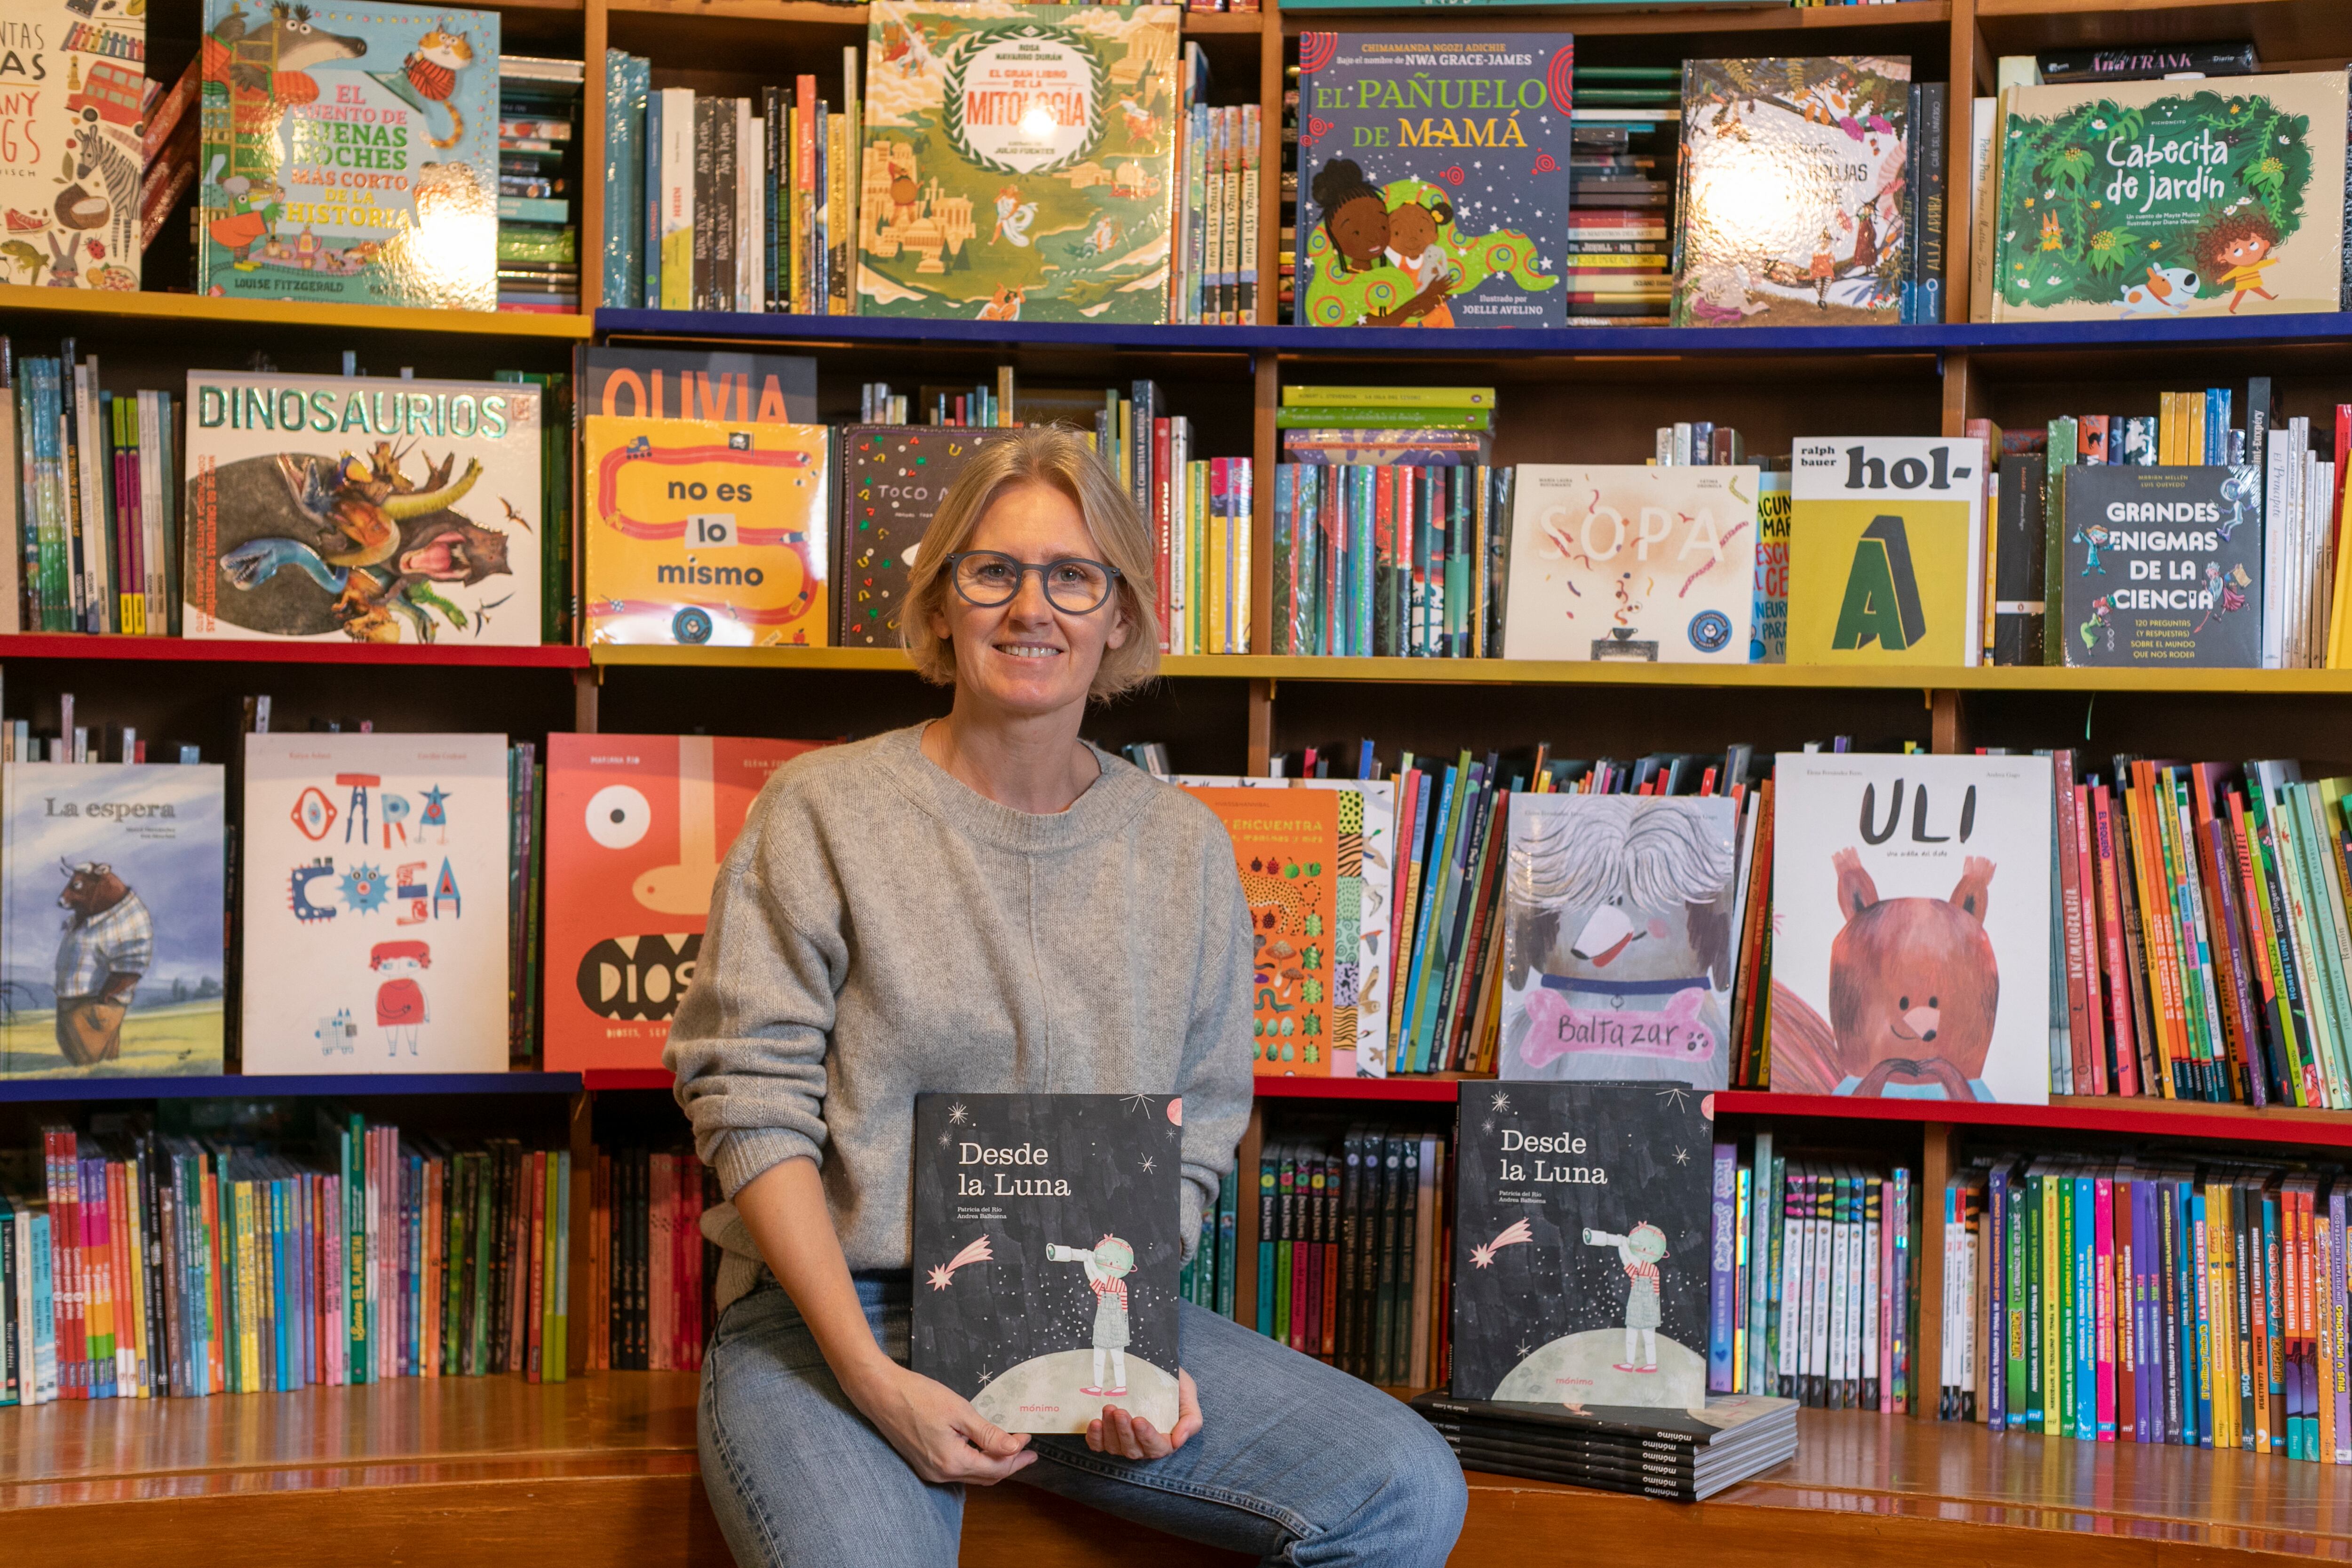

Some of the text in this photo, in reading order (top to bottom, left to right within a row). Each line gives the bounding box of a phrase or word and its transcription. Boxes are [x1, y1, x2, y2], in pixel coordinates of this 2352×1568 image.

[1361, 43, 1430, 53] CHIMAMANDA
[1404, 54, 1533, 66] NWA GRACE-JAMES
[2129, 52, 2193, 70] FRANK
[336, 86, 366, 104] EL
[1316, 72, 1548, 110] EL PAÑUELO
[293, 104, 406, 125] CUENTO DE
[292, 119, 407, 147] BUENAS
[1352, 109, 1528, 148] DE MAMÁ
[293, 142, 407, 170] NOCHES
[2106, 128, 2228, 168] Cabecita
[1979, 137, 1991, 182] Peter Pan
[291, 166, 408, 191] MÁS CORTO
[325, 188, 376, 205] DE LA
[2106, 166, 2225, 213] de jardín
[286, 202, 413, 230] HISTORIA
[1923, 238, 1941, 271] ALLÁ
[1462, 305, 1543, 315] JOELLE AVELINO
[199, 385, 509, 439] DINOSAURIOS
[1801, 446, 1835, 456] ralph
[1801, 457, 1837, 466] bauer
[1843, 445, 1972, 489] hol-
[667, 481, 753, 502] no es
[877, 485, 928, 501] TOCO
[2270, 452, 2286, 518] El Principito
[2106, 501, 2220, 522] GRANDES
[697, 518, 727, 543] lo
[1538, 505, 1724, 563] SOPA
[2108, 531, 2219, 551] ENIGMAS
[658, 557, 764, 587] mismo
[2130, 560, 2196, 581] DE LA
[1832, 514, 1926, 651] A
[2113, 589, 2214, 610] CIENCIA
[2135, 619, 2191, 628] 120 PREGUNTAS
[2137, 629, 2190, 638] (Y RESPUESTAS)
[2130, 640, 2153, 648] SOBRE
[2133, 651, 2149, 659] QUE
[2169, 650, 2195, 659] RODEA
[45, 797, 176, 823] La espera
[1859, 777, 1976, 846] ULI
[1233, 820, 1323, 831] ENCUENTRA
[2098, 811, 2112, 859] EL PEQUEÑO
[2236, 833, 2253, 879] TERRIBLE
[2269, 881, 2297, 1000] HOMBRE LUNA Tomi Ungerer
[2337, 927, 2350, 961] Ramón
[599, 960, 697, 1003] DIOS
[1558, 1014, 1679, 1048] Baltazar
[1500, 1130, 1587, 1154] Desde
[958, 1142, 1049, 1166] Desde
[1499, 1159, 1608, 1185] la Luna
[958, 1173, 1072, 1196] la Luna
[2240, 1285, 2246, 1293] DE
[2254, 1281, 2261, 1289] LA
[2336, 1291, 2342, 1301] UN
[1555, 1377, 1594, 1386] mónimo
[2337, 1371, 2346, 1393] RIUS
[1019, 1404, 1060, 1412] mónimo
[1642, 1440, 1677, 1451] mónimo
[1657, 1431, 1692, 1442] mónimo
[1642, 1452, 1677, 1463] mónimo
[1642, 1464, 1677, 1475] mónimo
[1642, 1476, 1677, 1487] mónimo
[1644, 1486, 1679, 1497] mónimo
